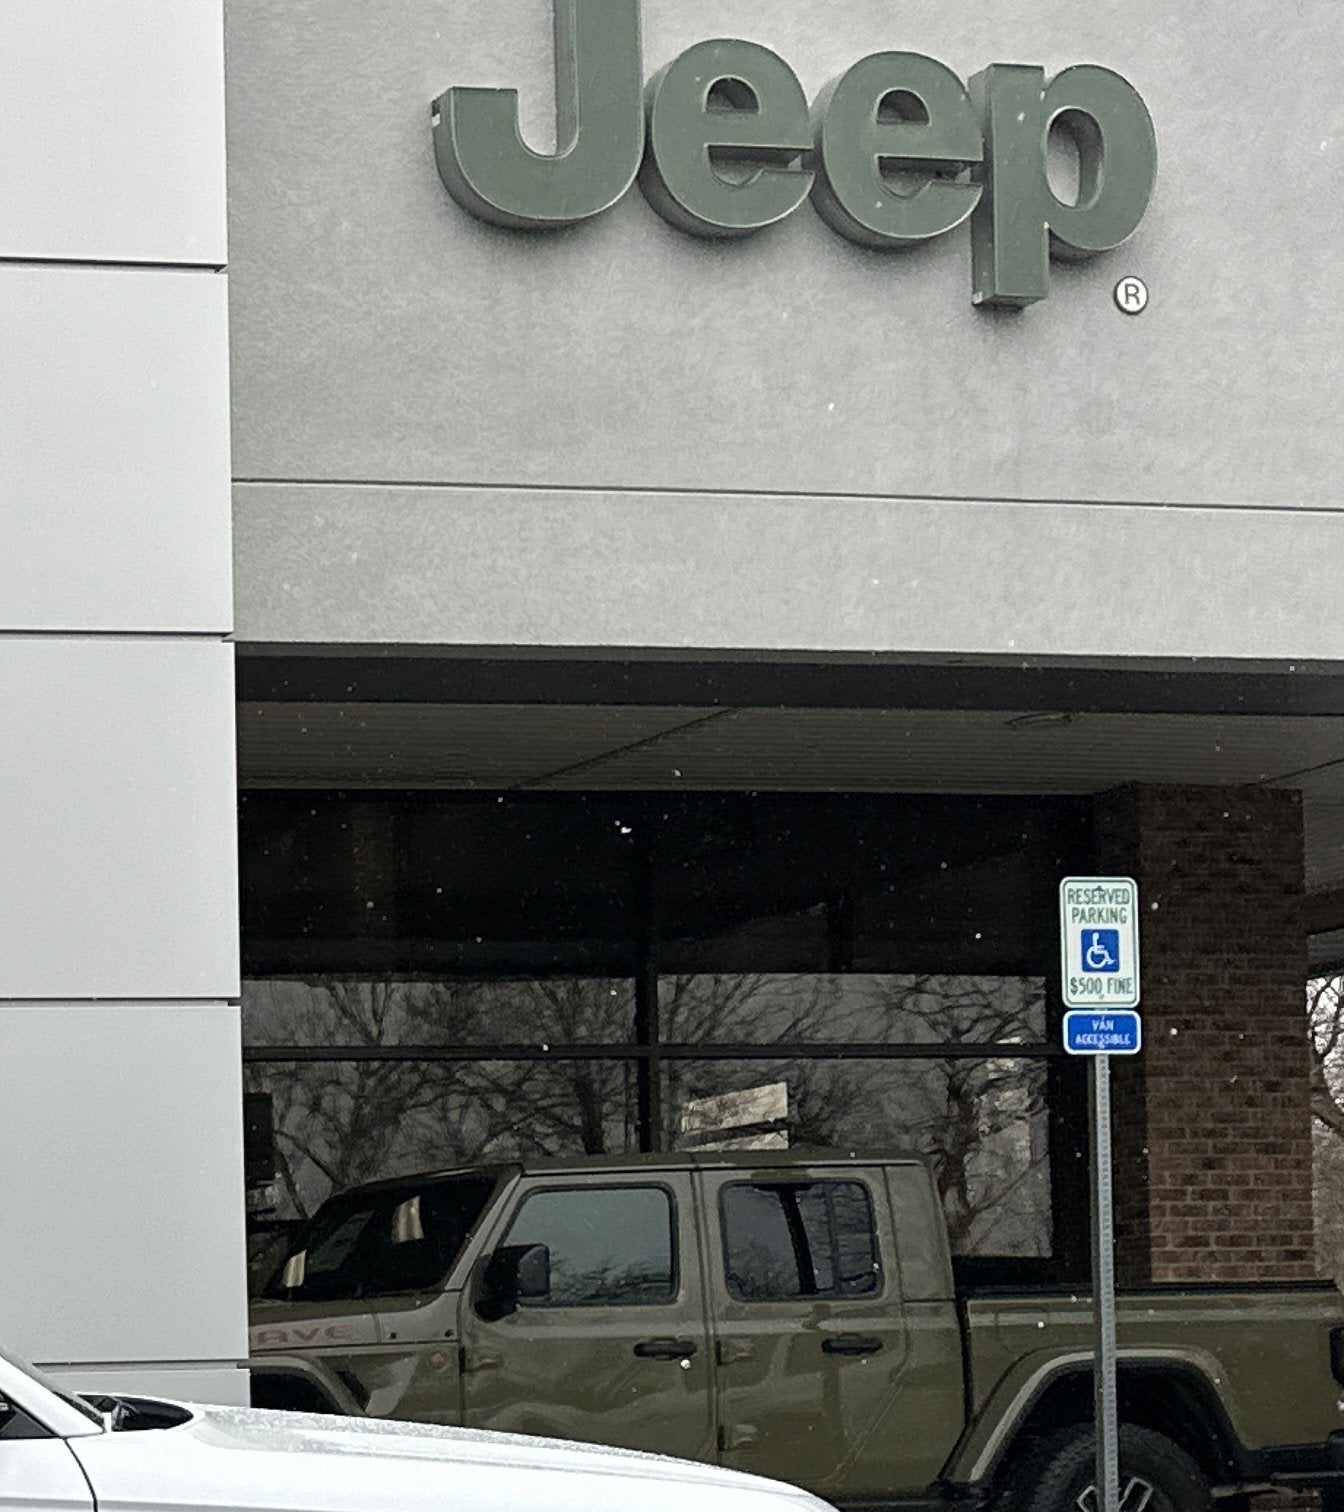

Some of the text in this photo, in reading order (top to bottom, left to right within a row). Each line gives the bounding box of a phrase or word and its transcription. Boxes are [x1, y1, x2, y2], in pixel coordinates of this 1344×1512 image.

[433, 0, 1157, 304] Jeep
[1067, 888, 1130, 905] RESERVED
[1071, 907, 1128, 924] PARKING
[1070, 976, 1133, 995] $500 FINE
[1091, 1018, 1114, 1031] VAN
[1074, 1033, 1131, 1045] ACCESSIBLE
[253, 1323, 353, 1345] AVE
